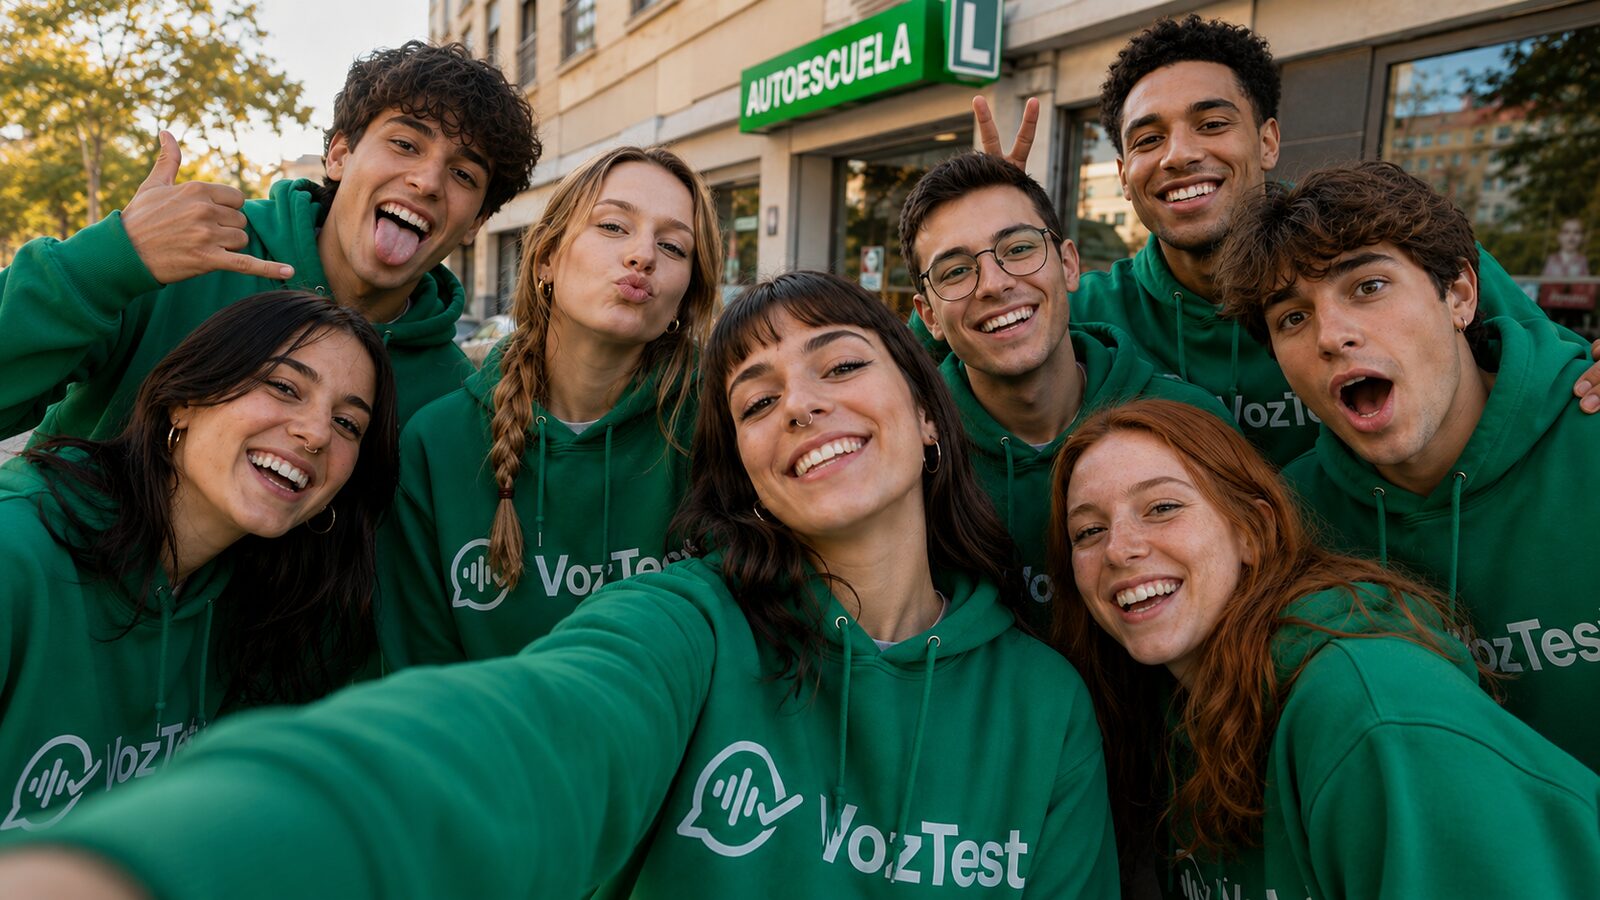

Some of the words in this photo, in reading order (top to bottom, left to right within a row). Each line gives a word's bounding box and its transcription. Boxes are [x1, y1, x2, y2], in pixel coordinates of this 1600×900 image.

[745, 23, 912, 117] AUTOESCUELA
[960, 1, 990, 66] L
[820, 794, 1028, 889] VozTest
